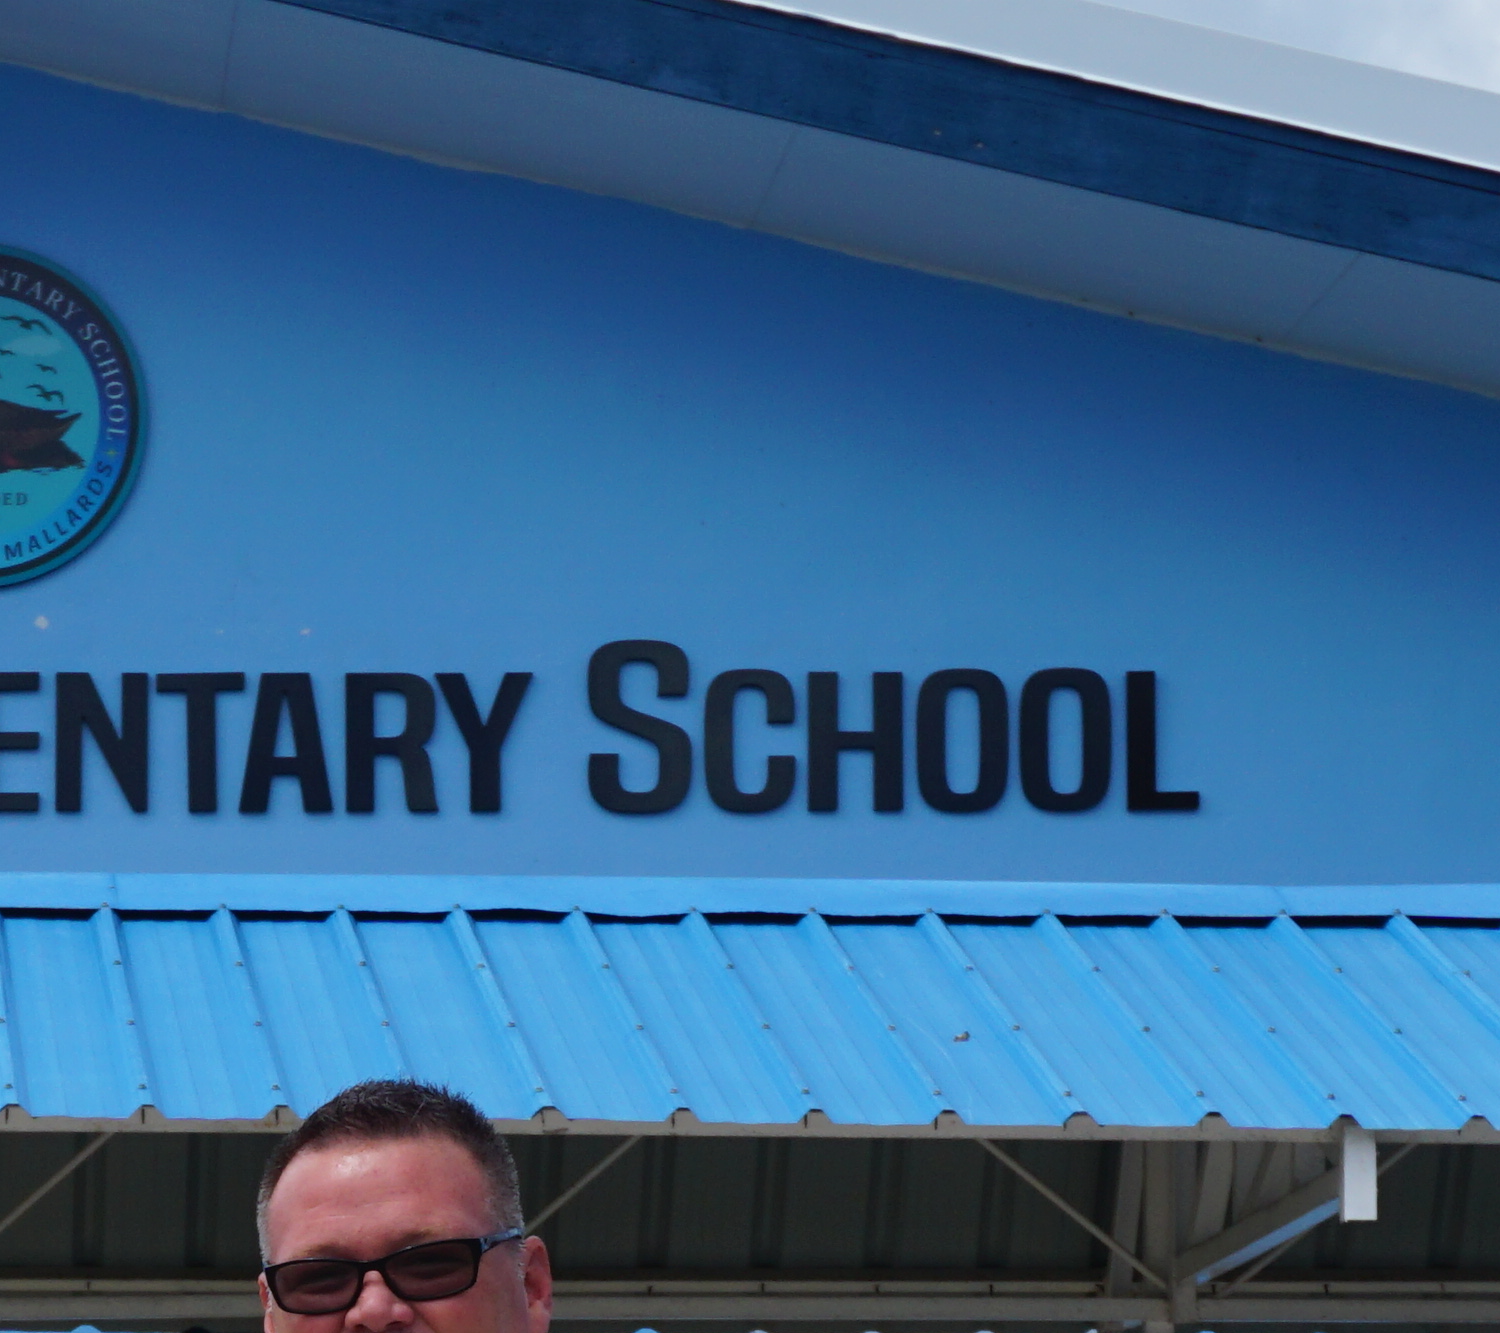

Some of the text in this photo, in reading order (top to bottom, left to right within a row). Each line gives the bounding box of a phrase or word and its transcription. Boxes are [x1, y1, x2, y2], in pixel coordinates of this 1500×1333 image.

[77, 322, 127, 441] SCHOOL
[3, 461, 114, 561] MALLARDS
[586, 638, 1202, 817] SCHOOL
